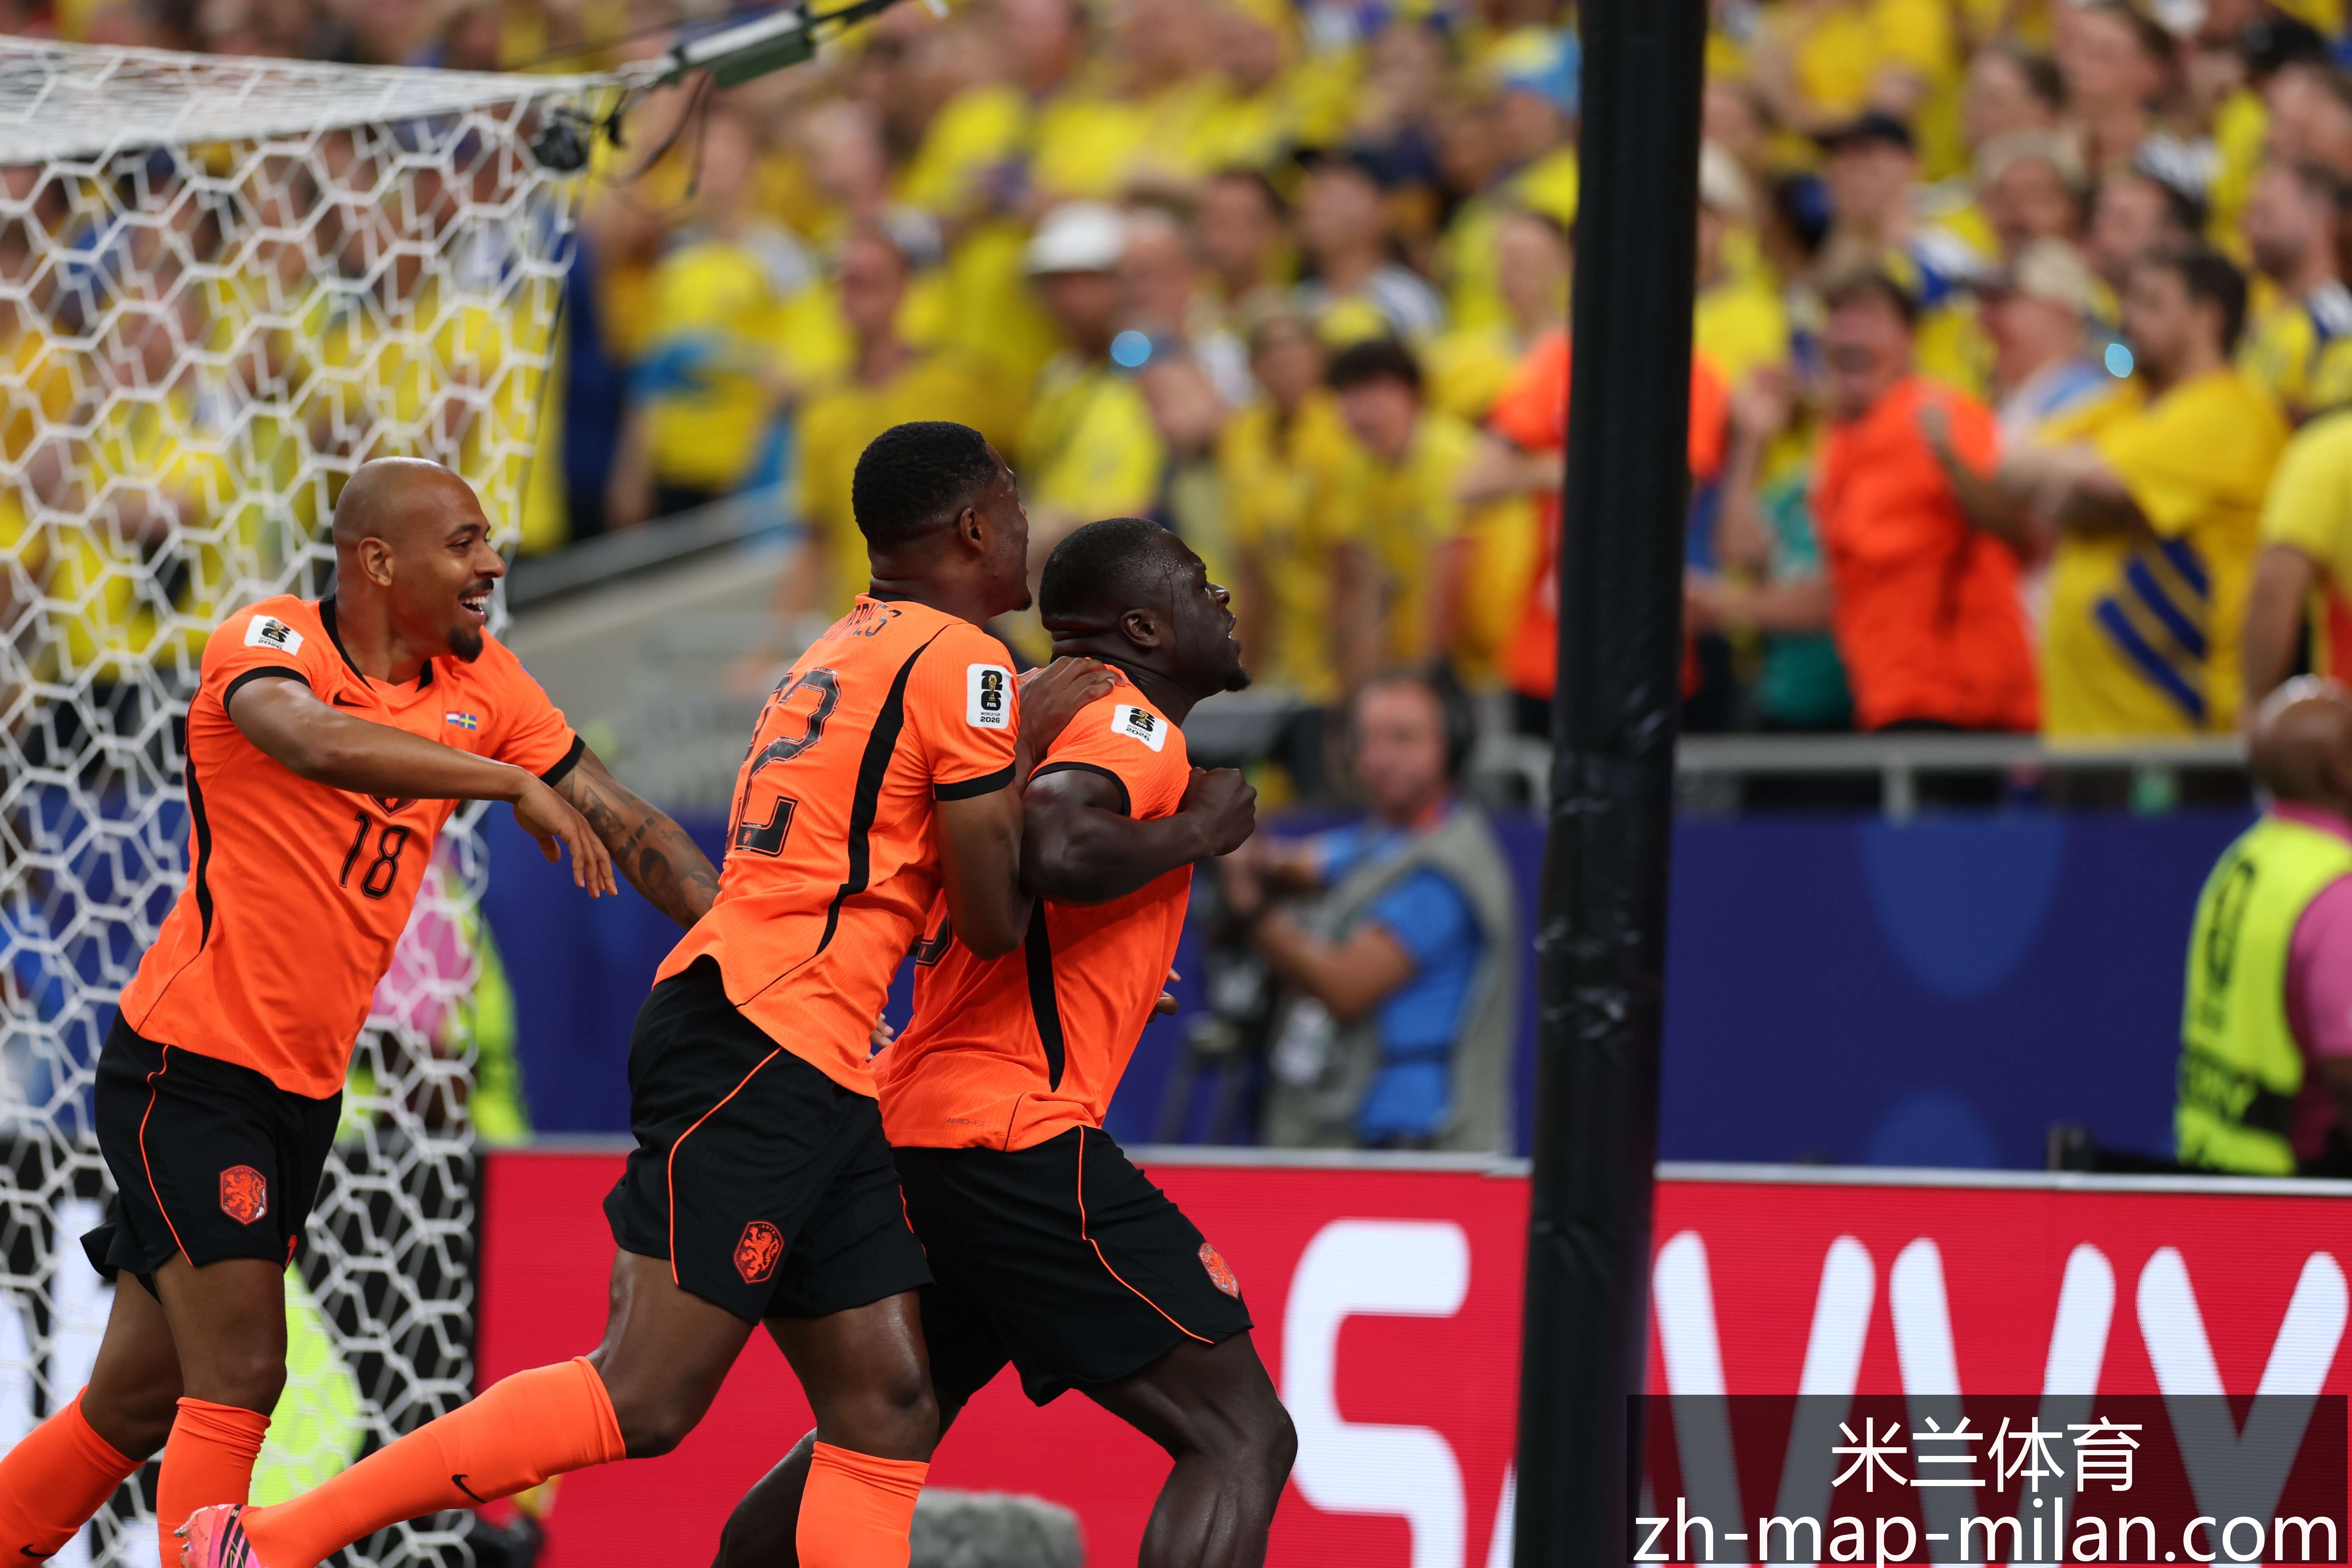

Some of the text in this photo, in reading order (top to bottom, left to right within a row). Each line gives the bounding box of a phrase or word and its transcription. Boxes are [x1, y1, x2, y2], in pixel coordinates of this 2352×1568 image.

[258, 639, 282, 650] 2026
[1126, 727, 1150, 741] 2026
[339, 811, 410, 900] 18
[947, 1117, 991, 1126] AERO-FIT
[1280, 1217, 2350, 1568] SVVY
